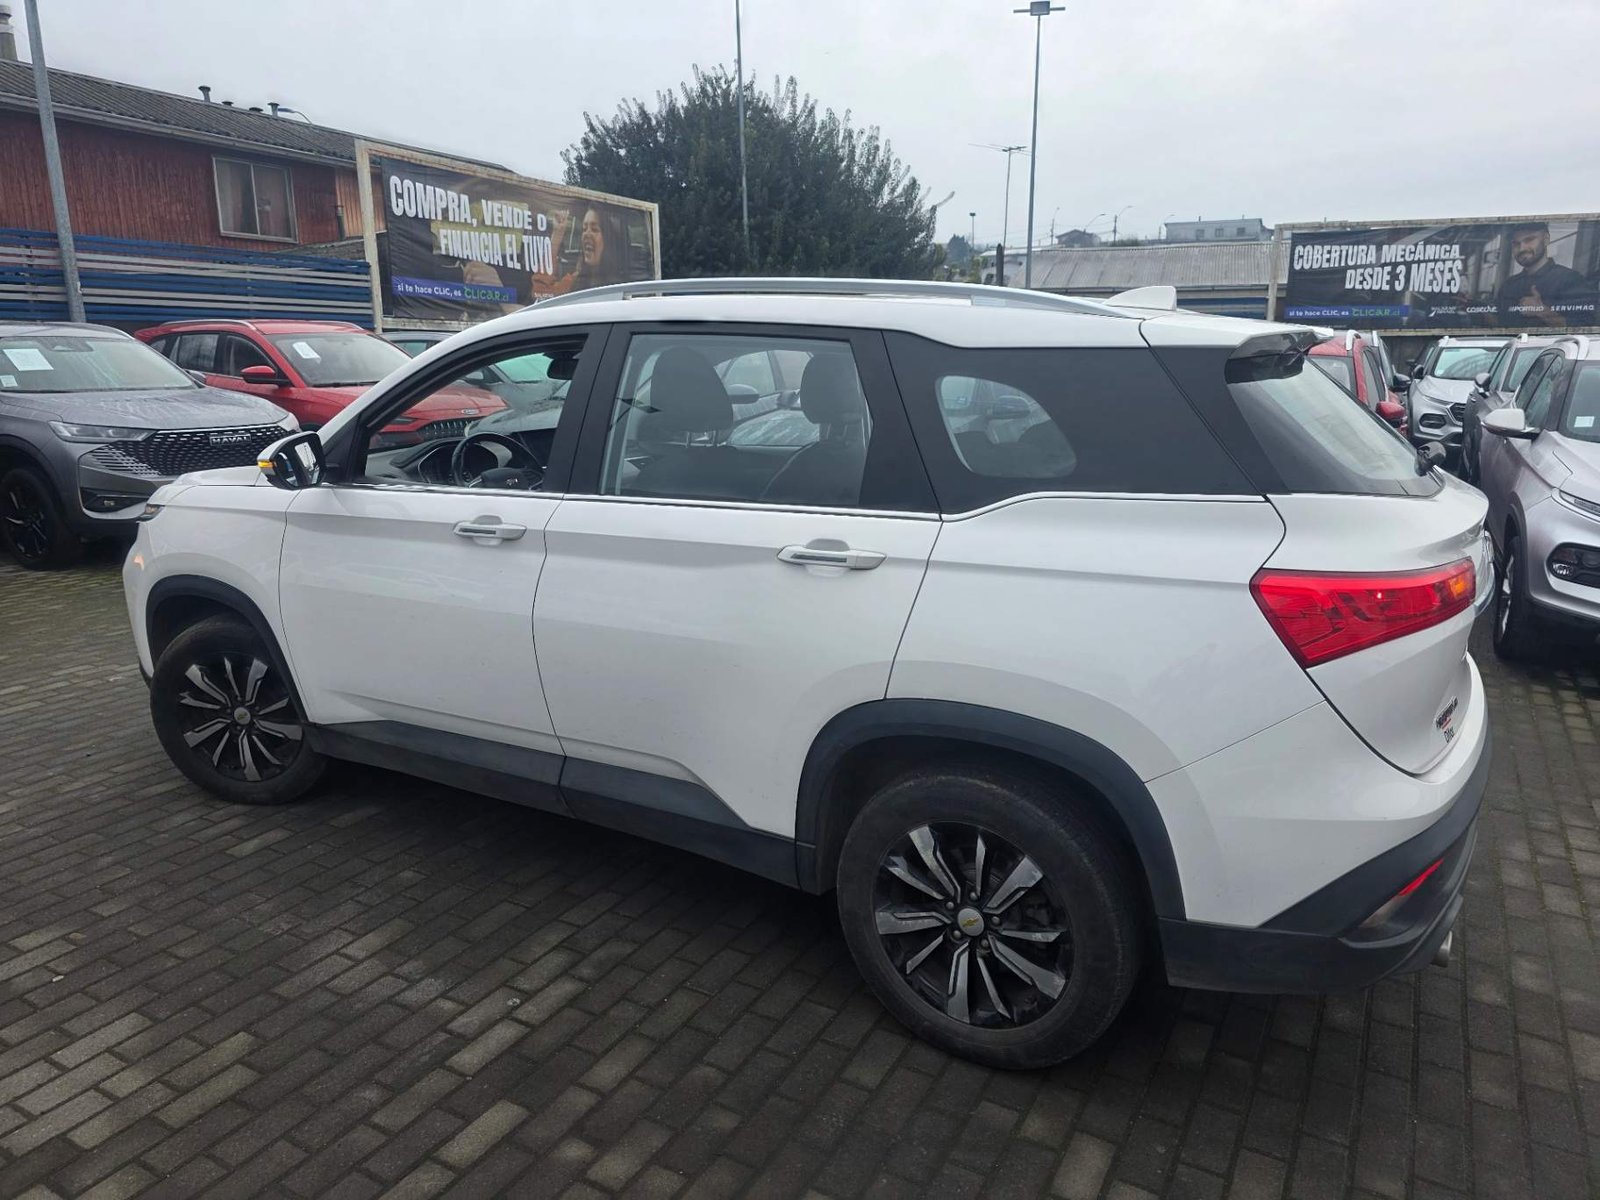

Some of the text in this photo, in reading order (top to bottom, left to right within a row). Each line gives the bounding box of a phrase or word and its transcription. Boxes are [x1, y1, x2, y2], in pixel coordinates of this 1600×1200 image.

[390, 175, 477, 227] COMPRA,
[481, 199, 533, 230] VENDE
[439, 229, 554, 276] FINANCIA EL TUYO
[1293, 244, 1377, 270] COBERTURA
[397, 282, 404, 292] si
[405, 284, 414, 293] te
[415, 284, 433, 295] hace
[453, 289, 462, 297] es
[1344, 259, 1463, 294] DESDE 3 MESES
